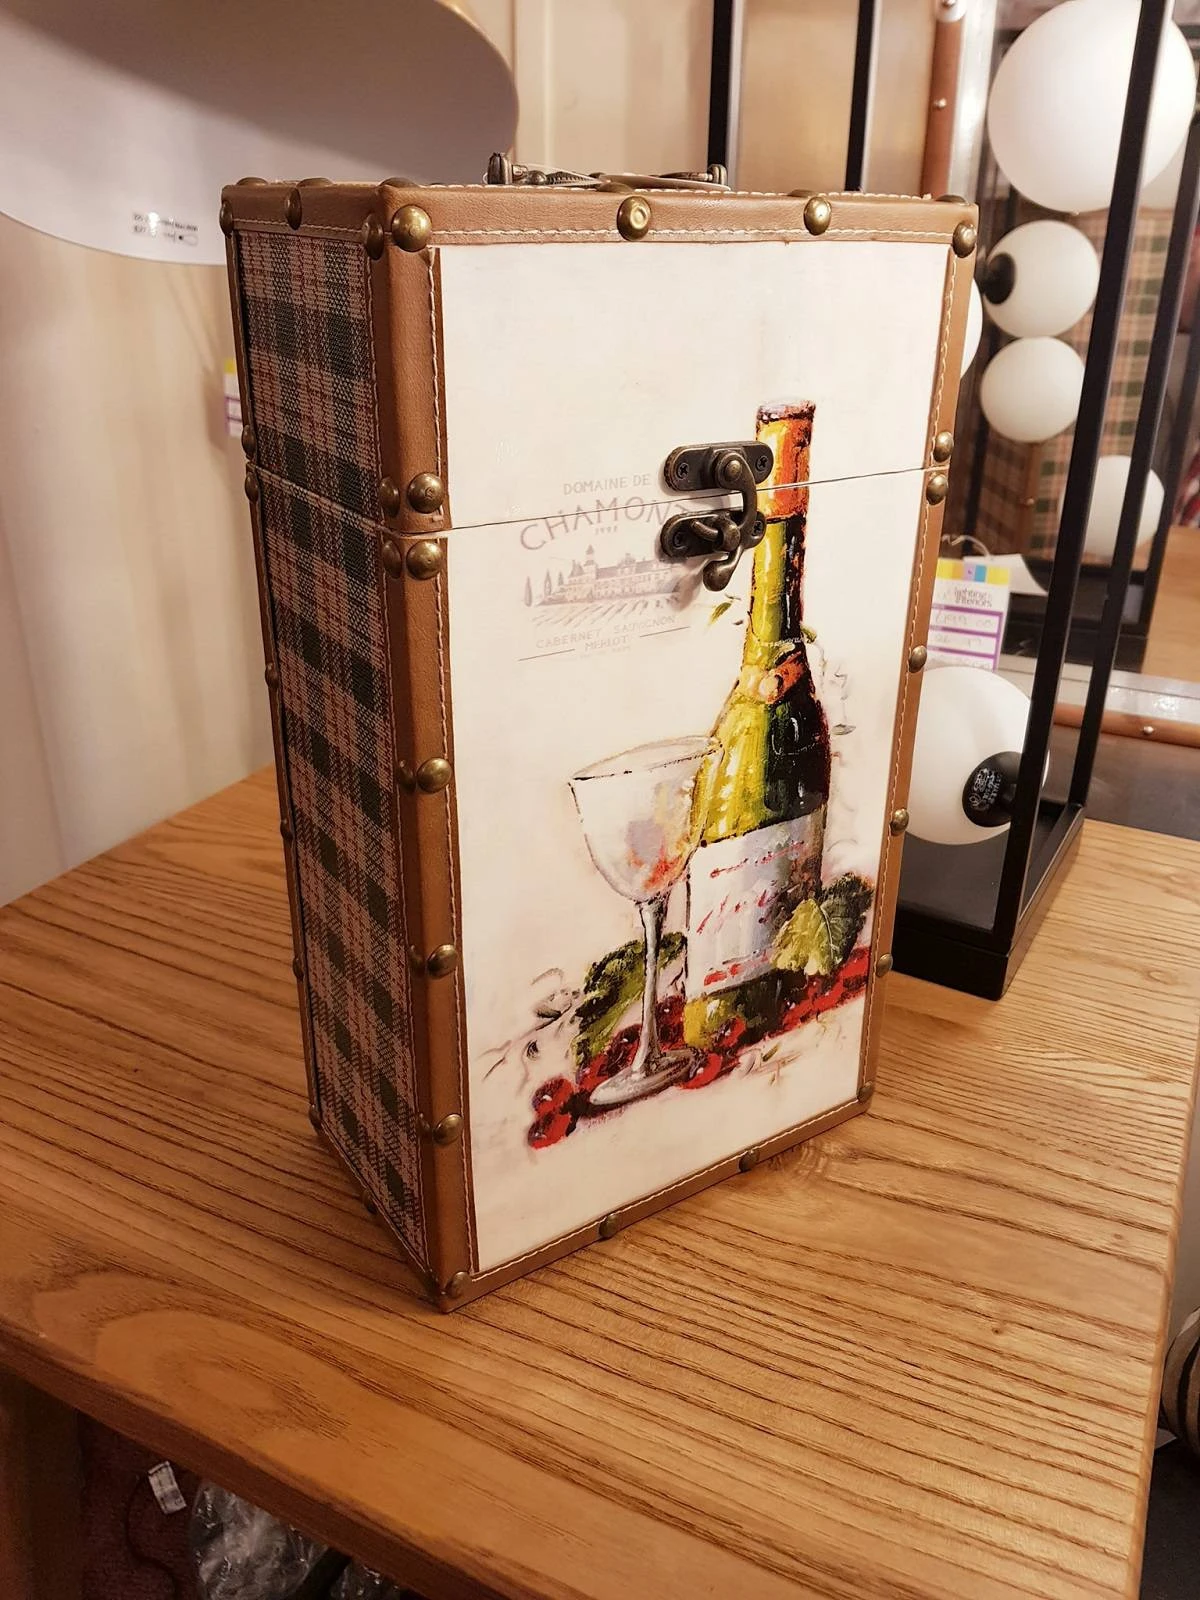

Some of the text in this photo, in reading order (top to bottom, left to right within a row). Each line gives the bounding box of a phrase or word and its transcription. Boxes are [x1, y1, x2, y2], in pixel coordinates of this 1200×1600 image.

[563, 473, 652, 496] DOMAINE DE
[535, 628, 602, 649] CABERNET
